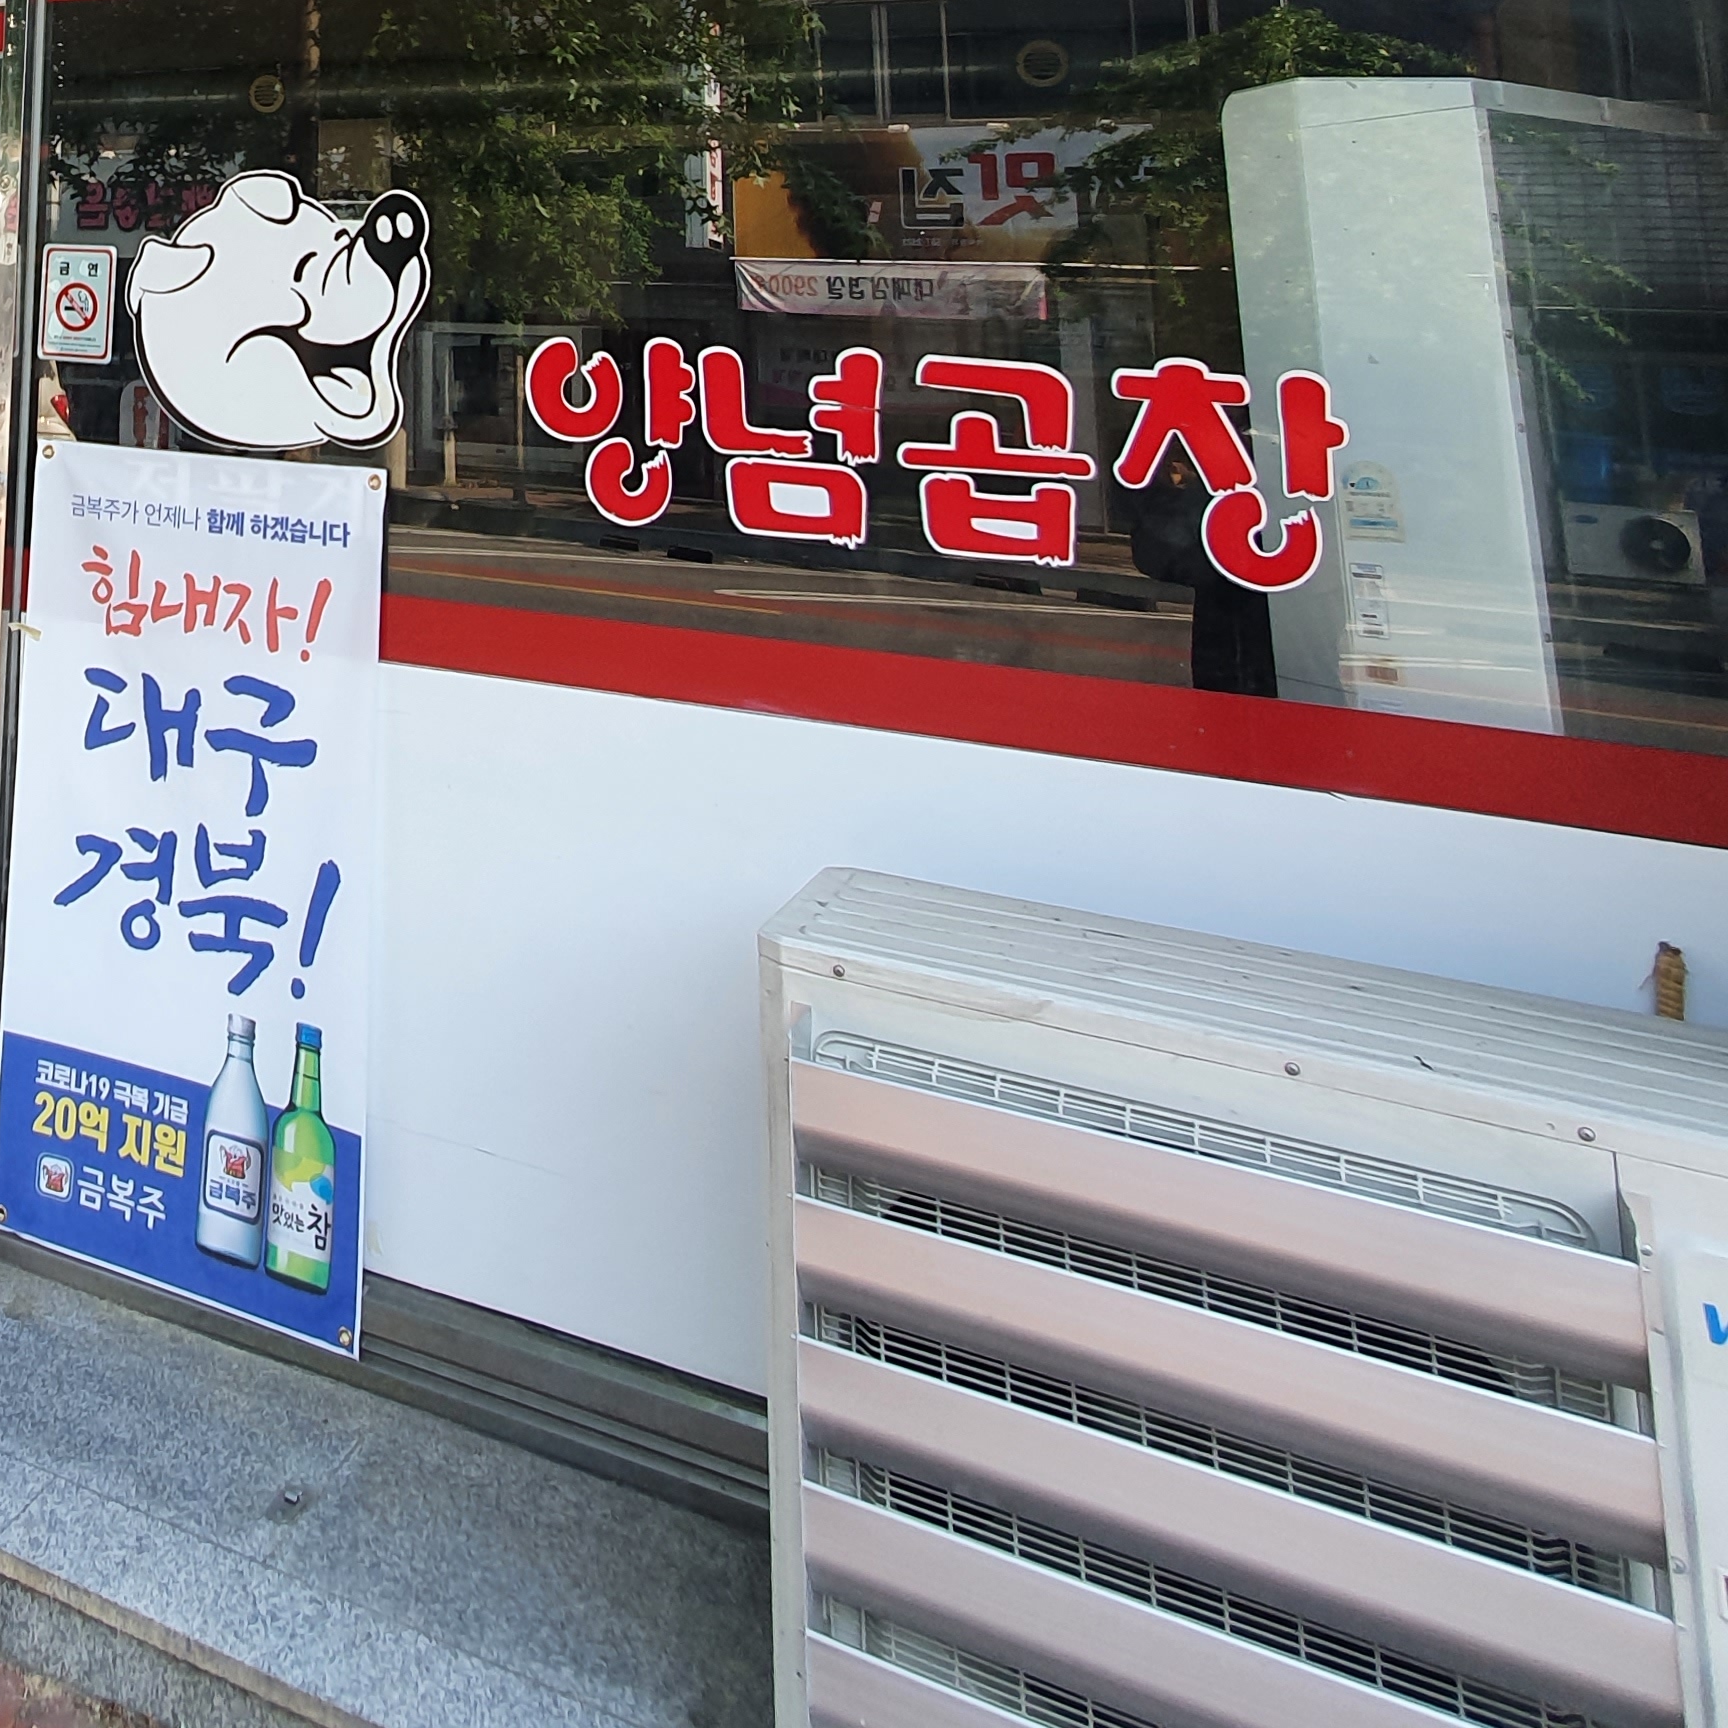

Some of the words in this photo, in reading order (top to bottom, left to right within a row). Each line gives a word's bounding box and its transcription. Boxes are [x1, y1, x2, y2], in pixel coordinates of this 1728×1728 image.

[526, 336, 1350, 592] 양념곱창
[71, 494, 139, 526] 금복주가
[144, 501, 202, 531] 언제나
[206, 509, 244, 535] 함께
[250, 513, 351, 548] 하겠습니다
[82, 545, 332, 661] 힘내자!
[84, 668, 318, 816] 대구
[54, 823, 341, 999] 경북!
[31, 1092, 109, 1152] 20억
[118, 1113, 186, 1177] 지원
[35, 1060, 109, 1100] 코로나19
[153, 1092, 189, 1124] 기금
[77, 1165, 166, 1230] 금복주
[272, 1202, 304, 1233] 맛있는
[307, 1203, 332, 1251] 참
